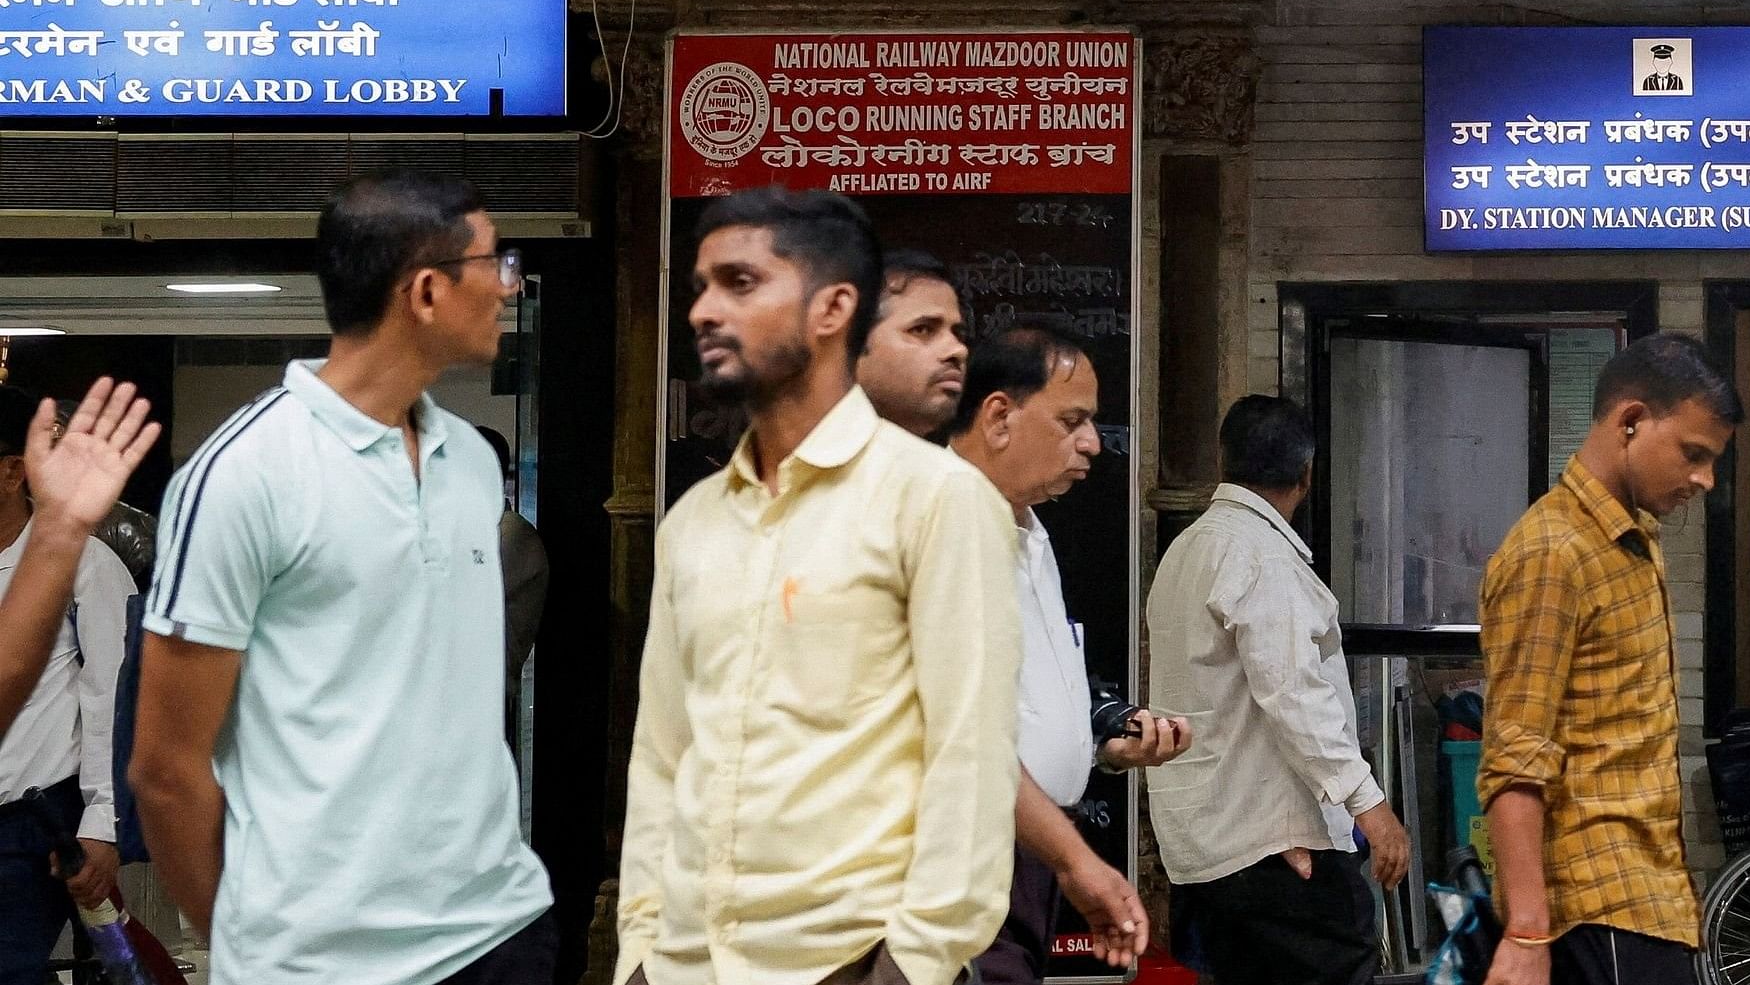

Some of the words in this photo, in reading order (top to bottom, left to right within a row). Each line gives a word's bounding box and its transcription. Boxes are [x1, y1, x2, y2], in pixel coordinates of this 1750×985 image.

[124, 20, 184, 57] एवं
[204, 20, 279, 57] गार्ड
[290, 20, 379, 57] लॉबी
[774, 43, 870, 69] NATIONAL
[876, 42, 960, 67] RAILWAY
[965, 42, 1060, 67] MAZDOOR
[1066, 42, 1128, 67] UNION
[117, 79, 151, 104] &
[162, 79, 313, 103] GUARD
[323, 78, 466, 103] LOBBY
[684, 75, 705, 114] WORKERS
[708, 98, 737, 108] NRMU
[773, 106, 860, 132] LOCO
[866, 105, 962, 131] RUNNING
[968, 104, 1032, 131] STAFF
[1039, 103, 1125, 130] BRANCH
[1451, 120, 1491, 146] उप
[1505, 114, 1588, 146] स्टेशन
[1604, 110, 1693, 145] प्रबंधक
[829, 173, 920, 192] AFFLIATED
[925, 173, 948, 191] TO
[952, 172, 992, 190] AIRF
[1451, 165, 1492, 192] उप
[1505, 159, 1591, 192] स्टेशन
[1604, 155, 1694, 190] प्रबंधक
[1440, 207, 1479, 232] DY.
[1484, 207, 1587, 231] STATION
[1592, 206, 1716, 230] MANAGER
